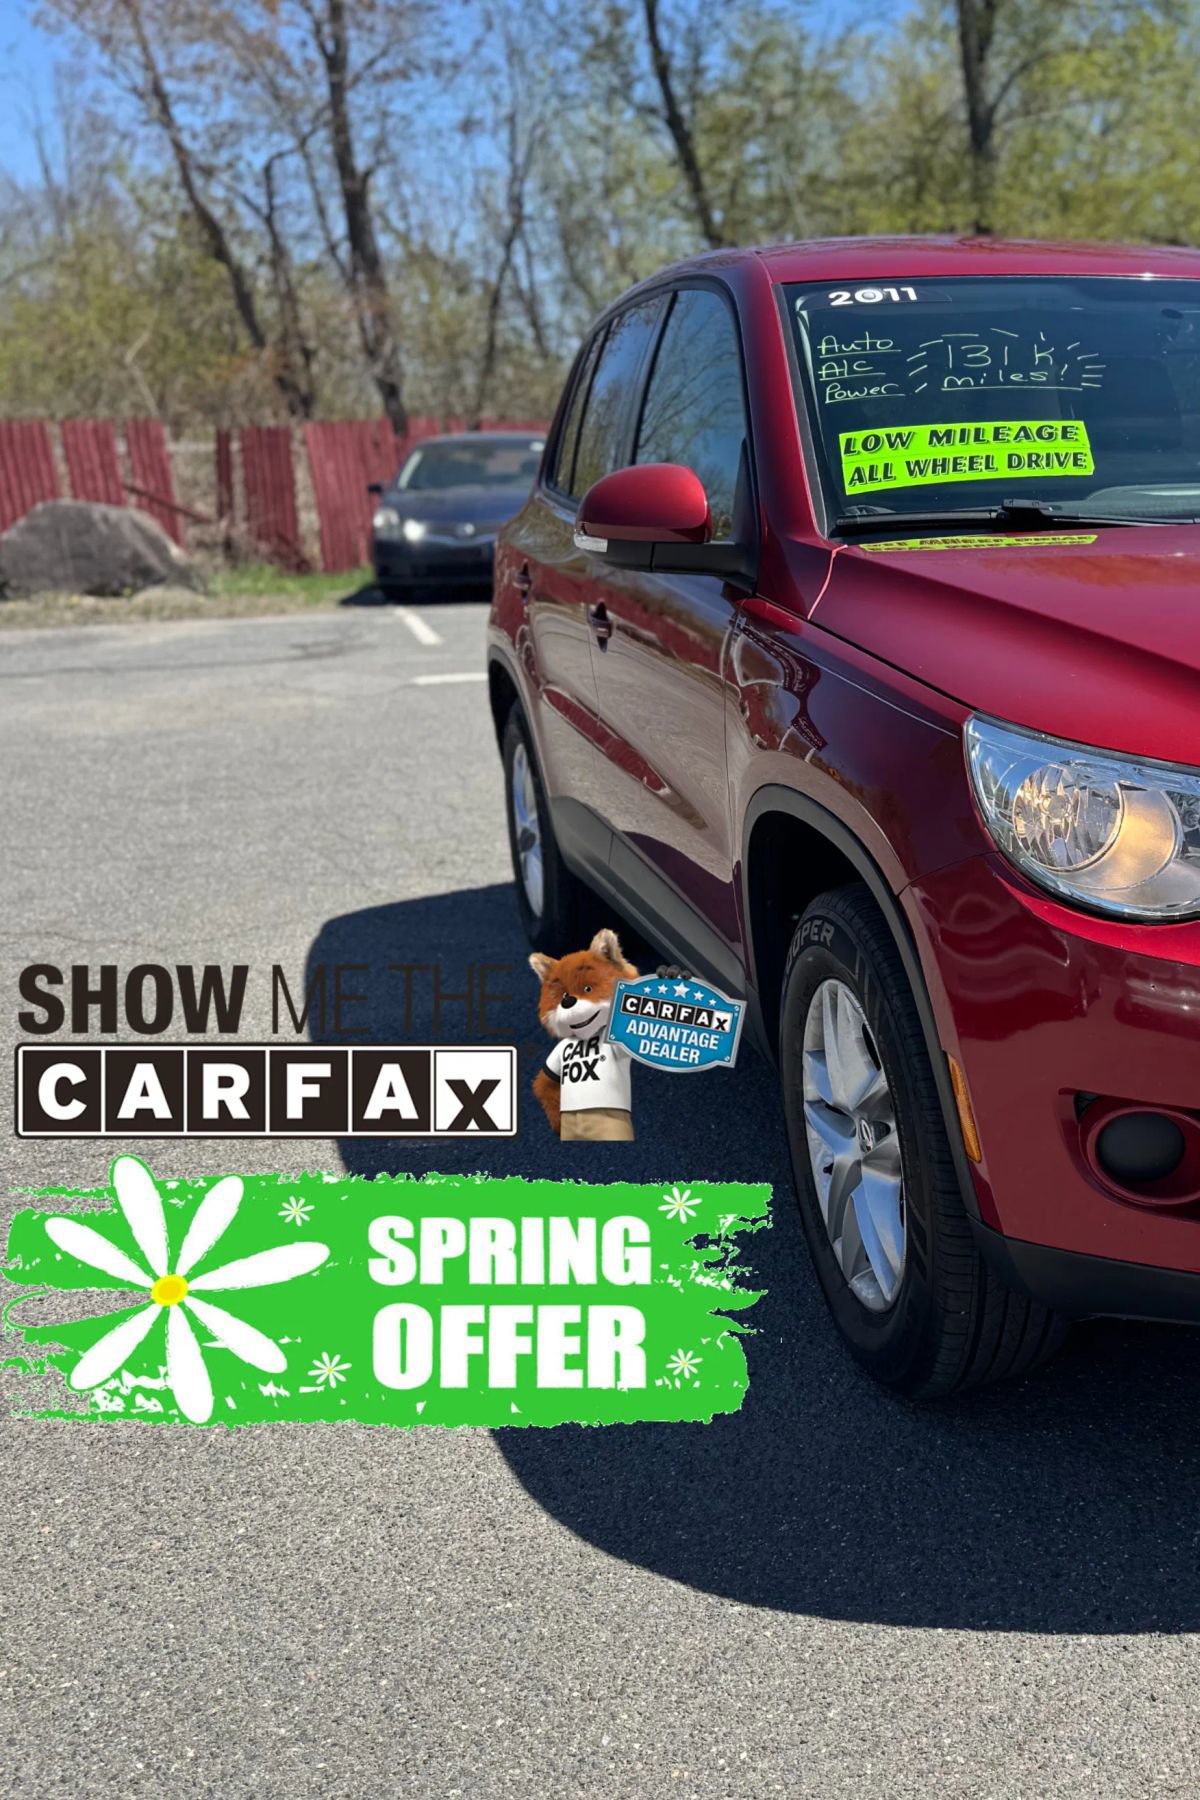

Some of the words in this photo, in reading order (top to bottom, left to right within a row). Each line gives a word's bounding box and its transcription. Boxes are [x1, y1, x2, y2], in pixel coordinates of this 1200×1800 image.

[828, 286, 918, 306] 2011
[817, 331, 894, 355] Auto
[948, 344, 1009, 368] 131
[825, 382, 900, 404] Power
[843, 432, 915, 456] LOW
[928, 424, 1080, 447] MILEAGE
[848, 463, 896, 487] ALL
[905, 455, 998, 479] WHEEL
[1007, 452, 1088, 470] DRIVE
